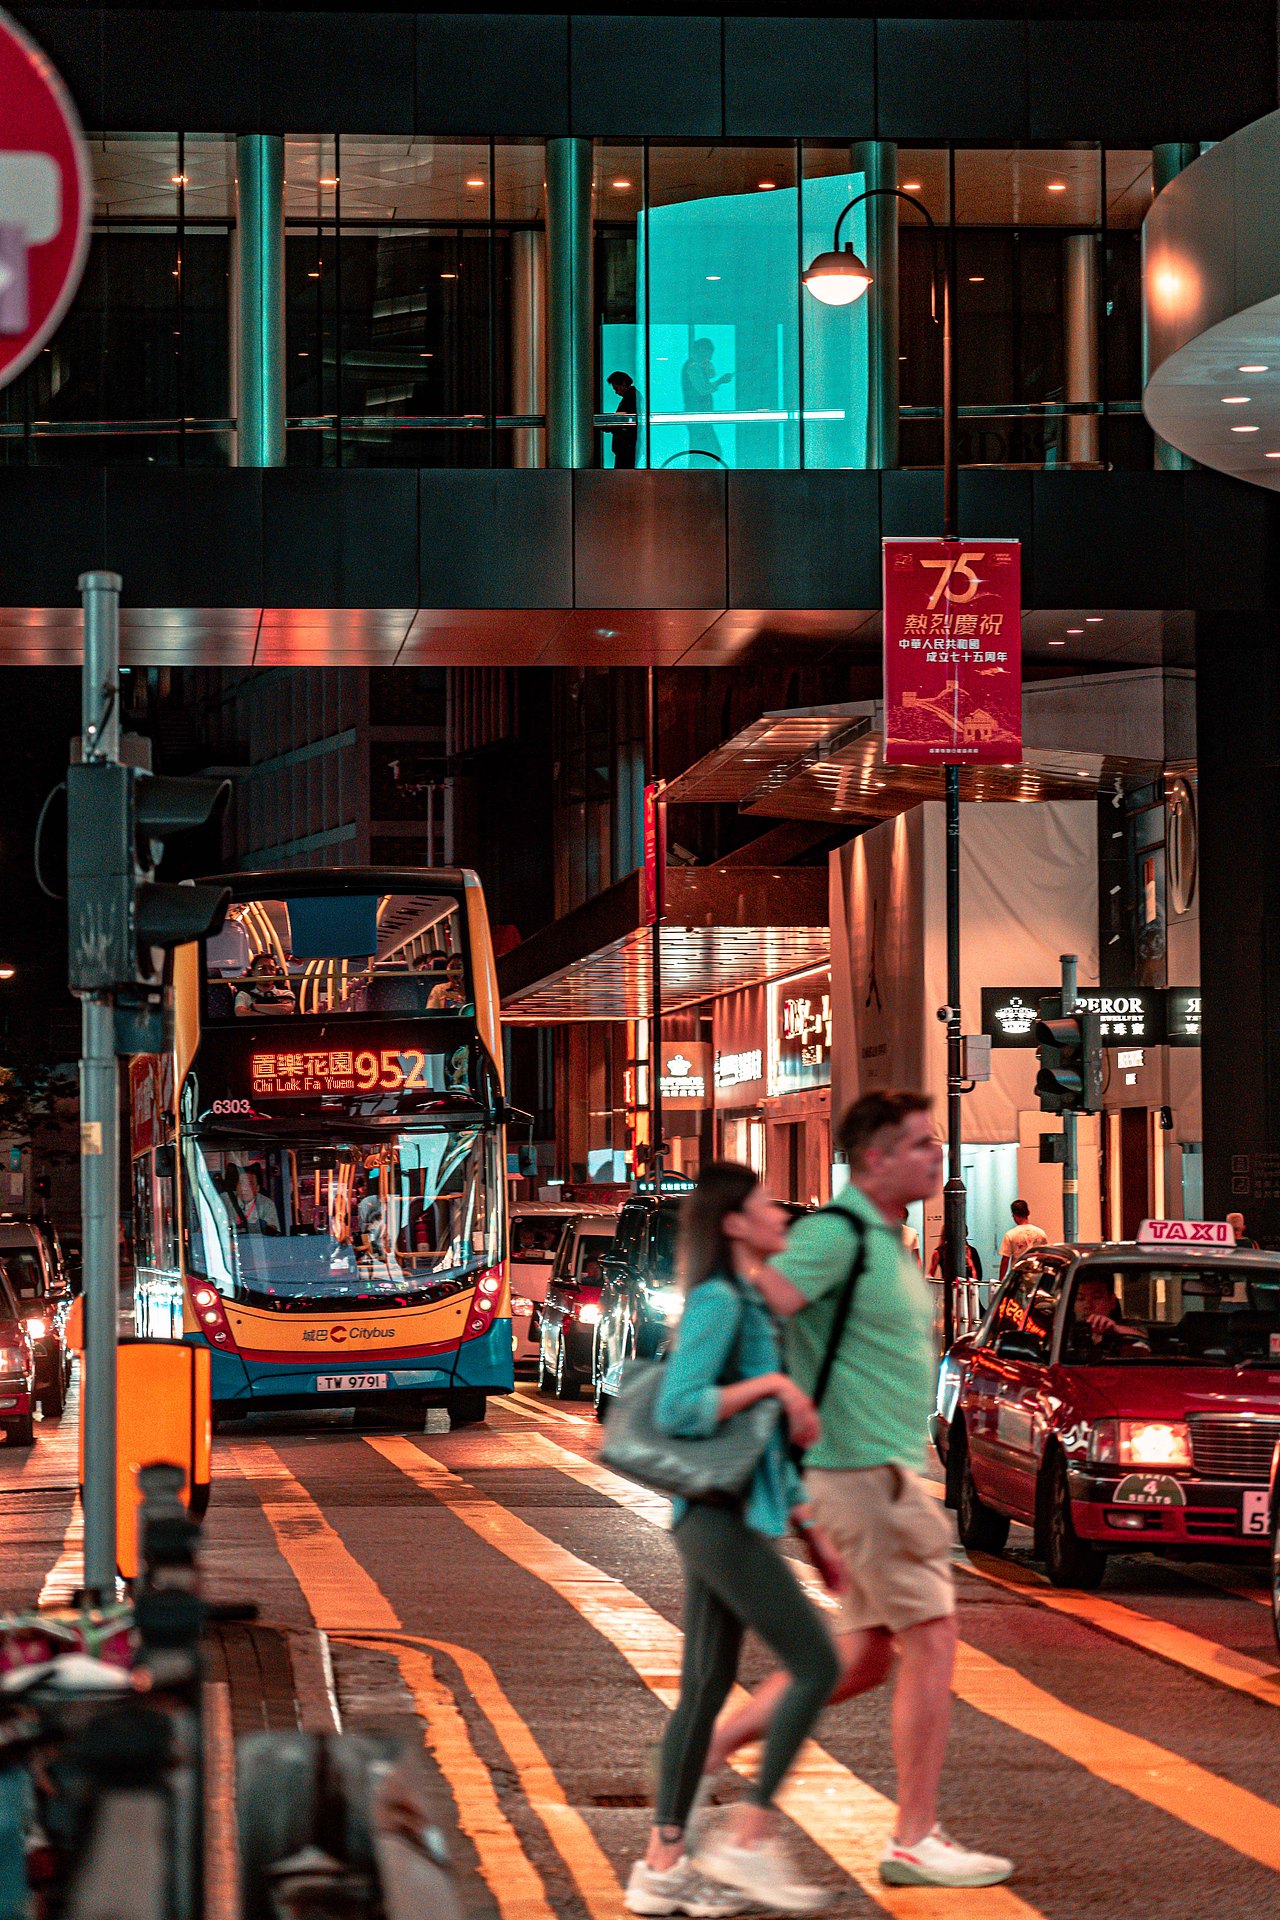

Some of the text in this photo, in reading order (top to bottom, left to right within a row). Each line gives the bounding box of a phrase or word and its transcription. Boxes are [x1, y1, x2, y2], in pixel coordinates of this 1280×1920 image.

[920, 552, 985, 610] 75
[903, 613, 1004, 635] 熱烈慶祝
[899, 638, 980, 650] 中華人民共和國
[926, 651, 1008, 662] 成立七十五周年
[1075, 998, 1144, 1014] PEROR
[252, 1051, 353, 1078] 置樂花園
[354, 1050, 428, 1089] 952
[253, 1076, 354, 1092] Chi Lok Fa Yuen
[213, 1099, 250, 1114] 6303
[1149, 1222, 1227, 1241] TAXI
[349, 1327, 396, 1340] Citybus
[325, 1376, 380, 1389] TW 9791
[1143, 1480, 1158, 1495] 4
[1250, 1512, 1267, 1532] 5
